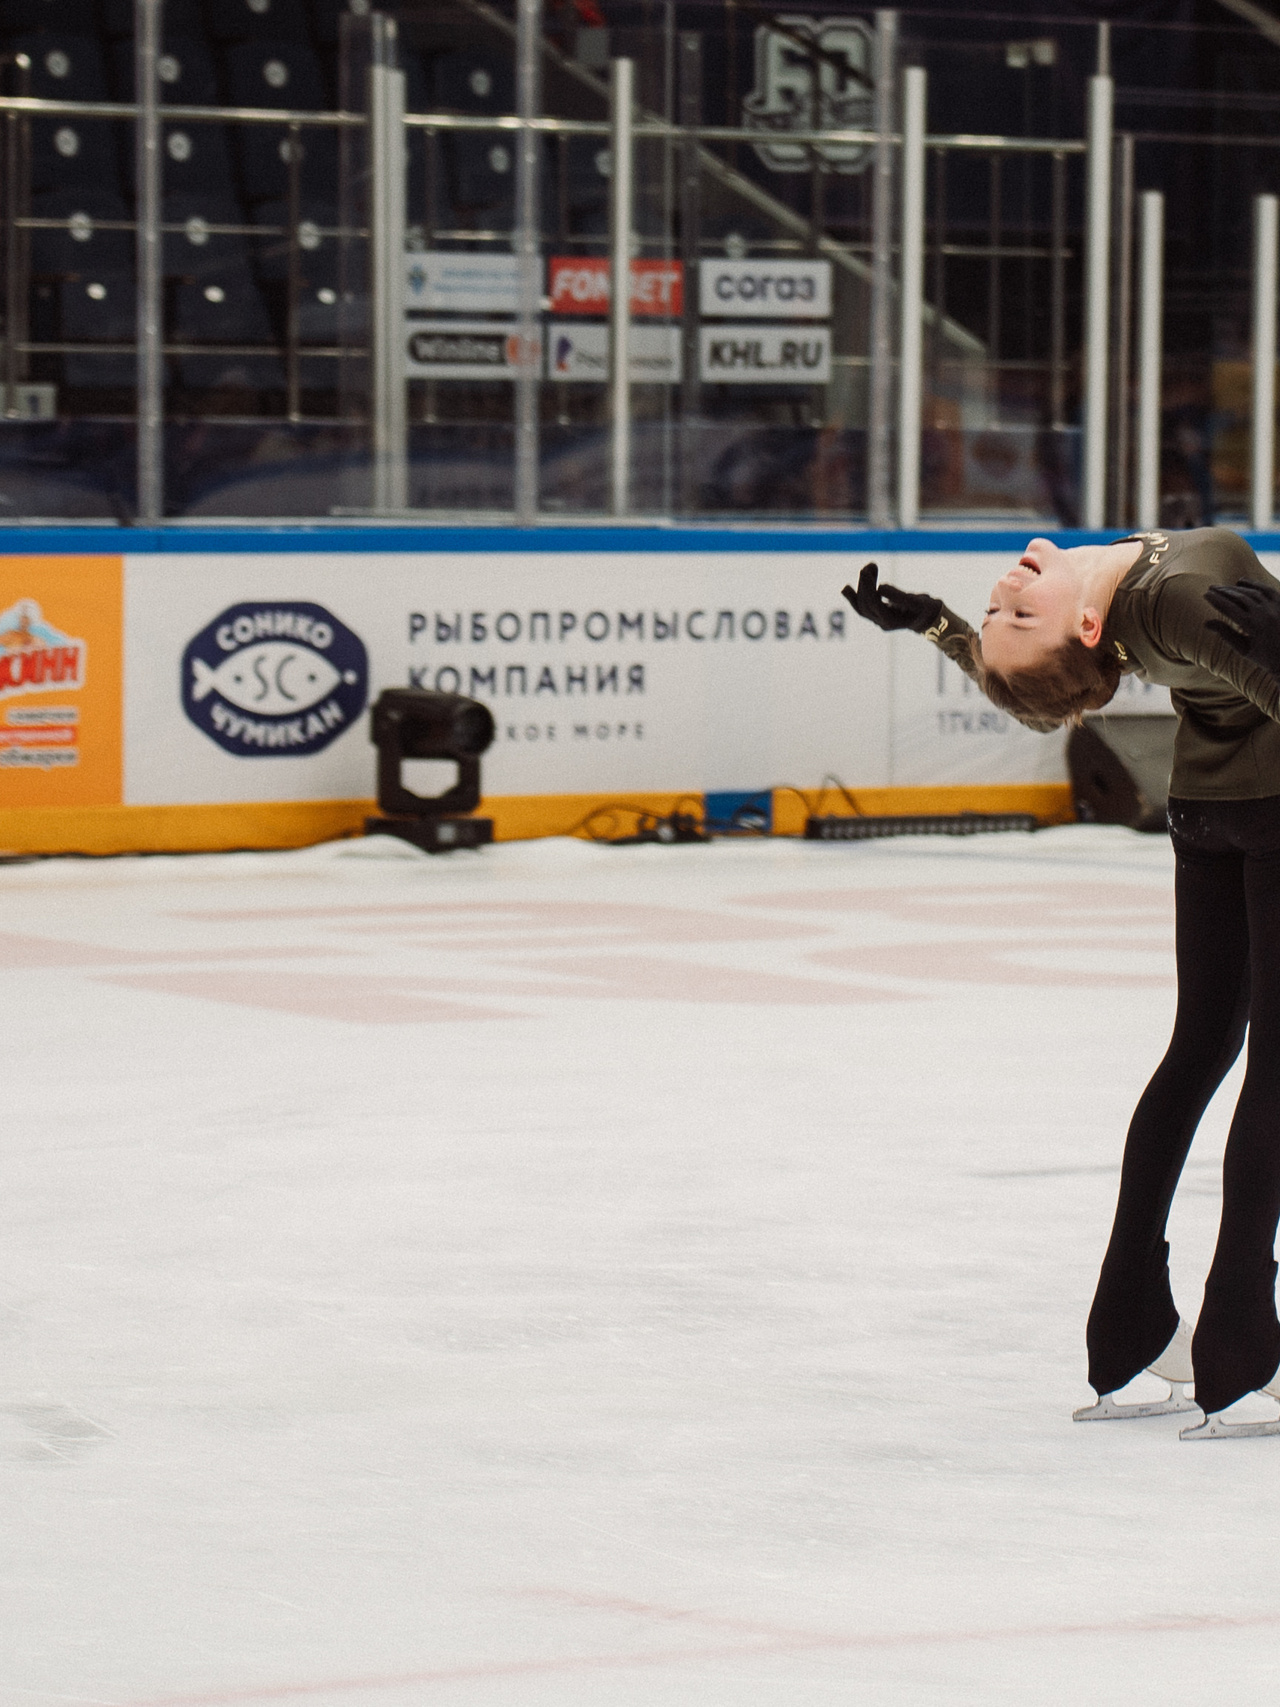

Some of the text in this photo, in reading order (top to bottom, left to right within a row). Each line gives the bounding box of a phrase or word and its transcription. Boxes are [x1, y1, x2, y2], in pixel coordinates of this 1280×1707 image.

[715, 274, 816, 301] согаз
[709, 340, 823, 369] KHL.RU
[215, 610, 335, 651] СОНИКО
[409, 611, 845, 642] РЫБОПРОМЫСЛОВАЯ
[409, 664, 645, 696] КОМПАНИЯ
[210, 700, 344, 748] ЧУМИКАН
